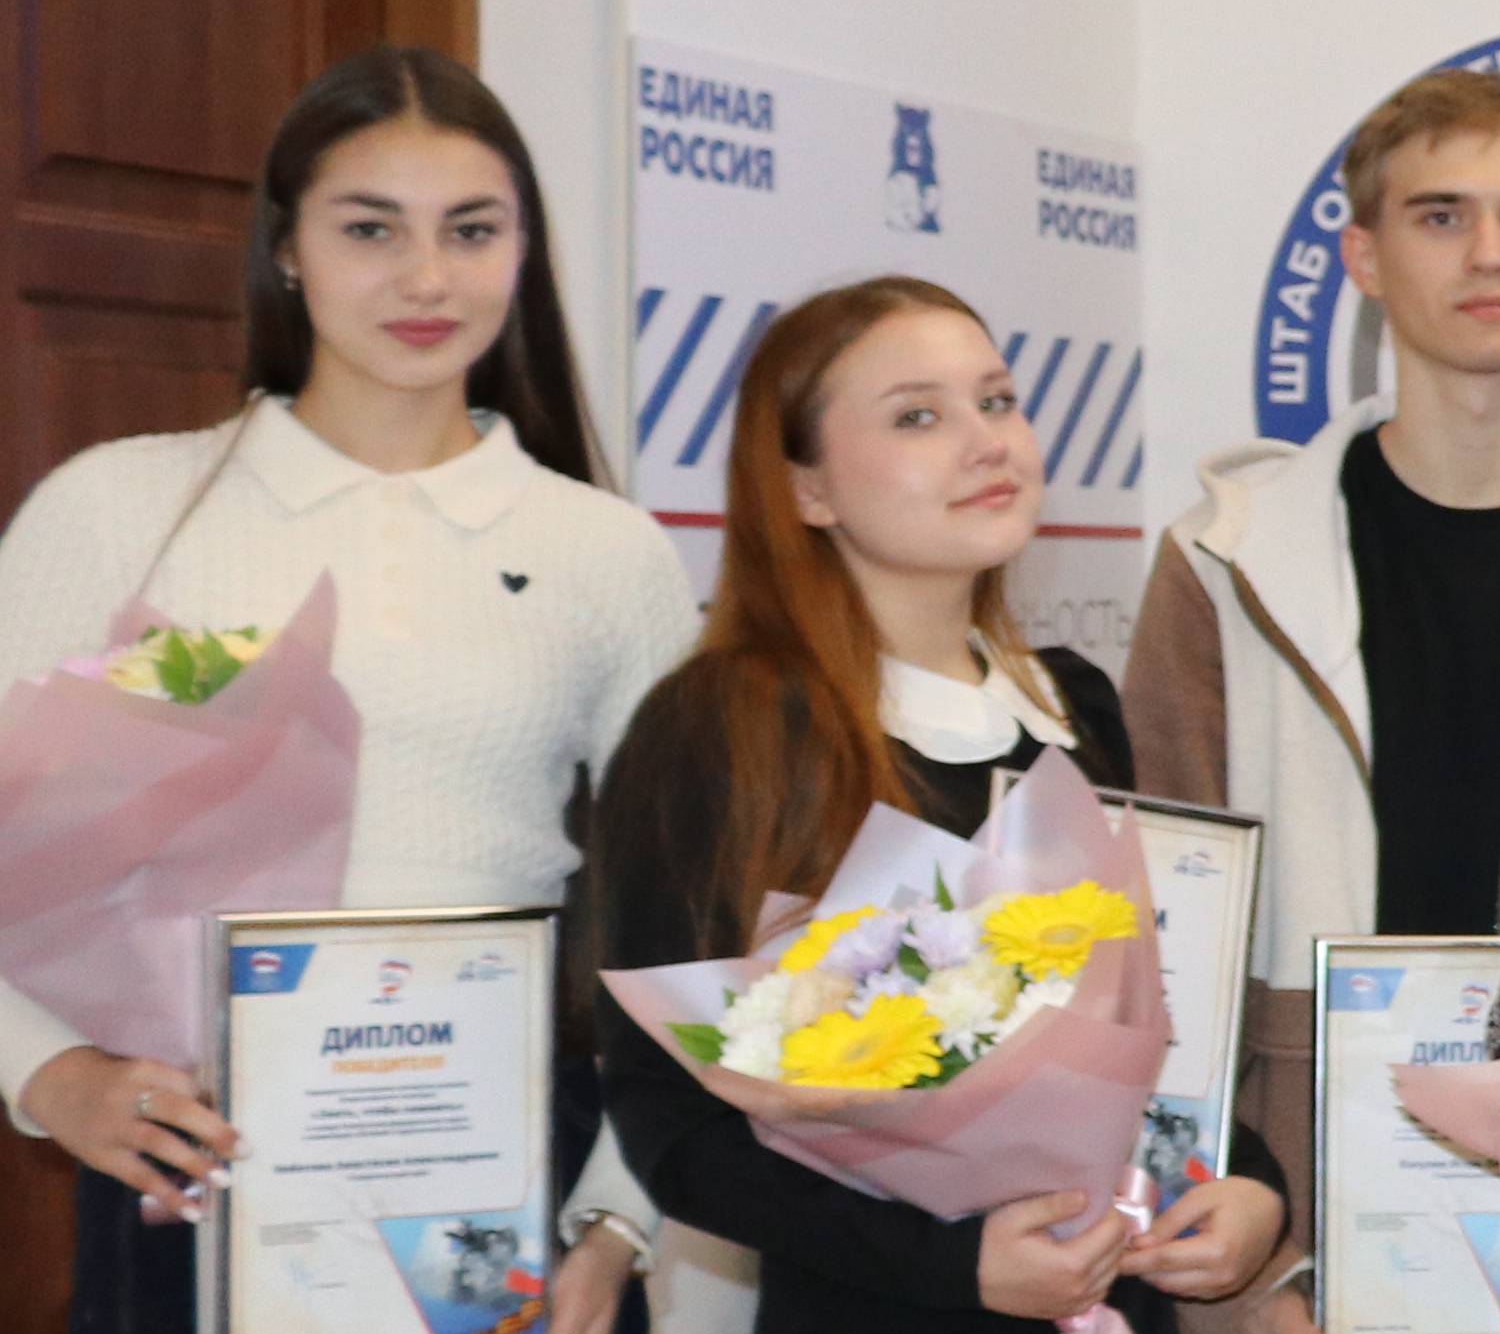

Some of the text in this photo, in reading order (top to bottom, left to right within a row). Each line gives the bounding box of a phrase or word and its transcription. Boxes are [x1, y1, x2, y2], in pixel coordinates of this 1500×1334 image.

[639, 66, 775, 132] ЕДИНАЯ
[640, 125, 776, 192] РОССИЯ
[1037, 148, 1137, 201] ЕДИНАЯ
[1038, 199, 1138, 250] РОССИЯ
[1268, 240, 1332, 405] ШТАБ
[321, 1021, 453, 1056] ДИПЛОМ
